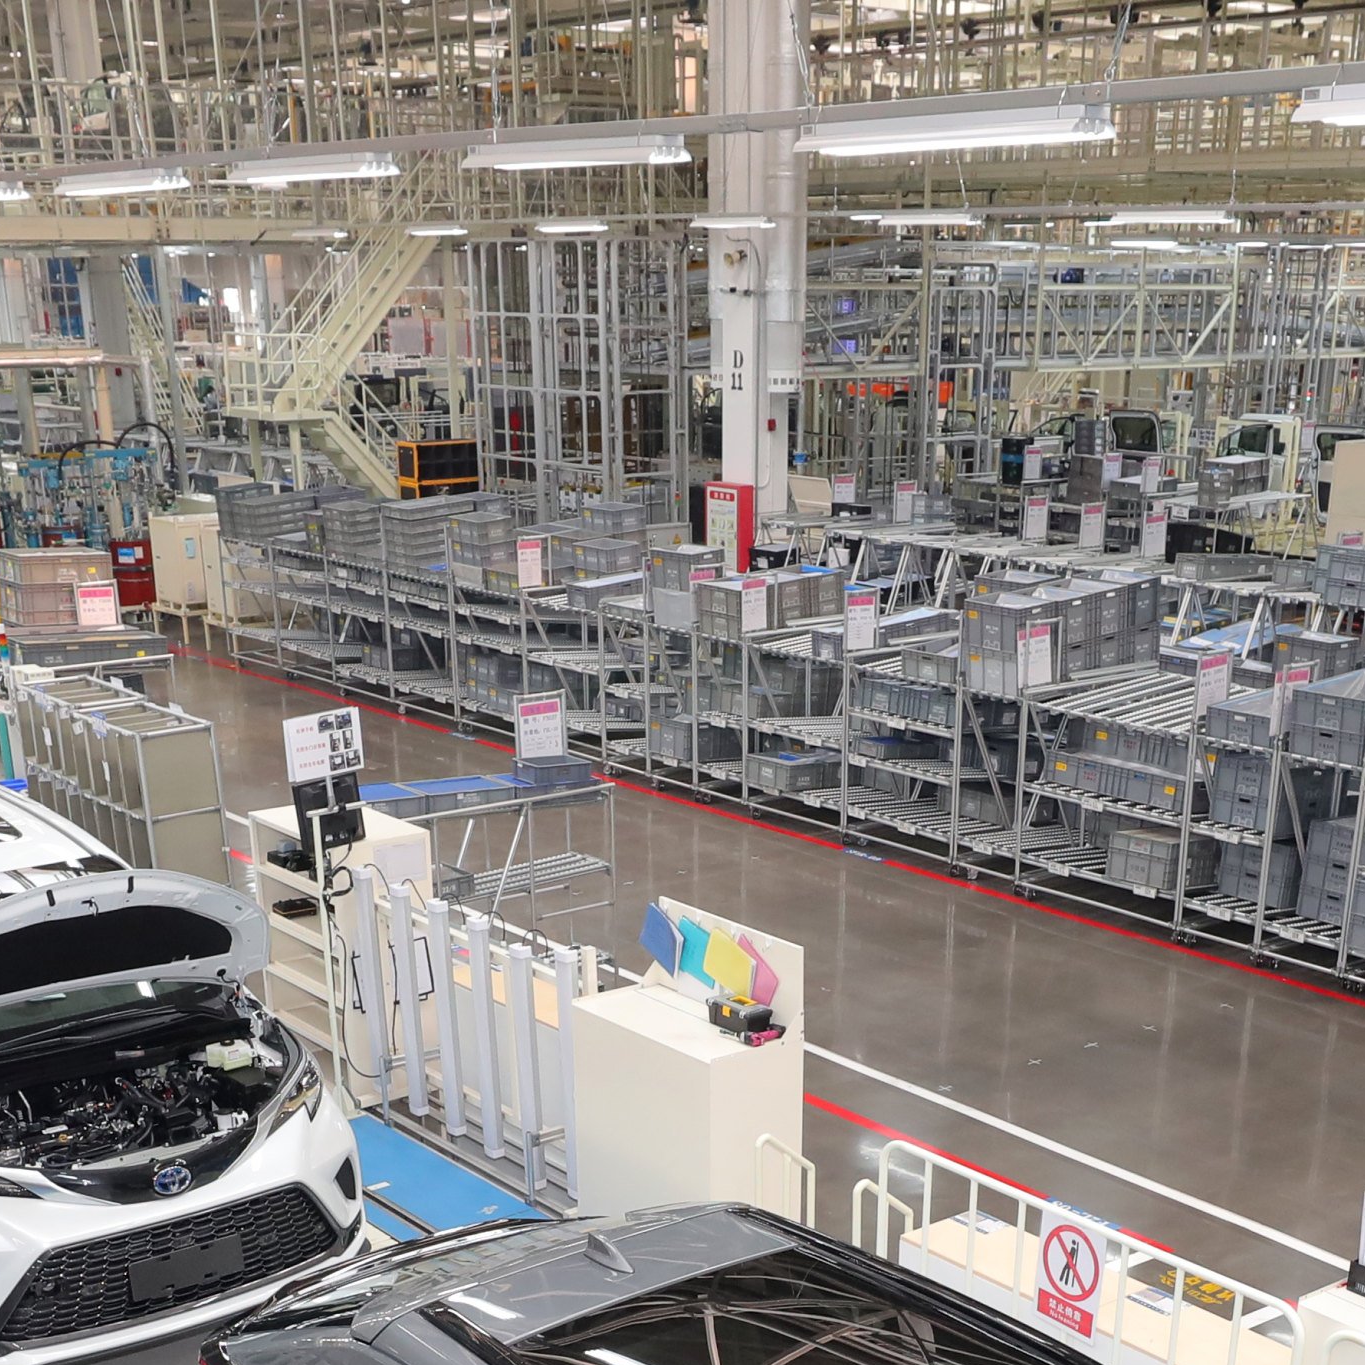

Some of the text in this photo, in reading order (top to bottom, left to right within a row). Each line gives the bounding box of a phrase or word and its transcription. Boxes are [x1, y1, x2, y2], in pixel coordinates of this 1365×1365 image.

[731, 350, 744, 368] D
[730, 373, 744, 390] 11
[1048, 1297, 1082, 1322] 禁止倚靠
[1059, 1312, 1080, 1330] leaning
